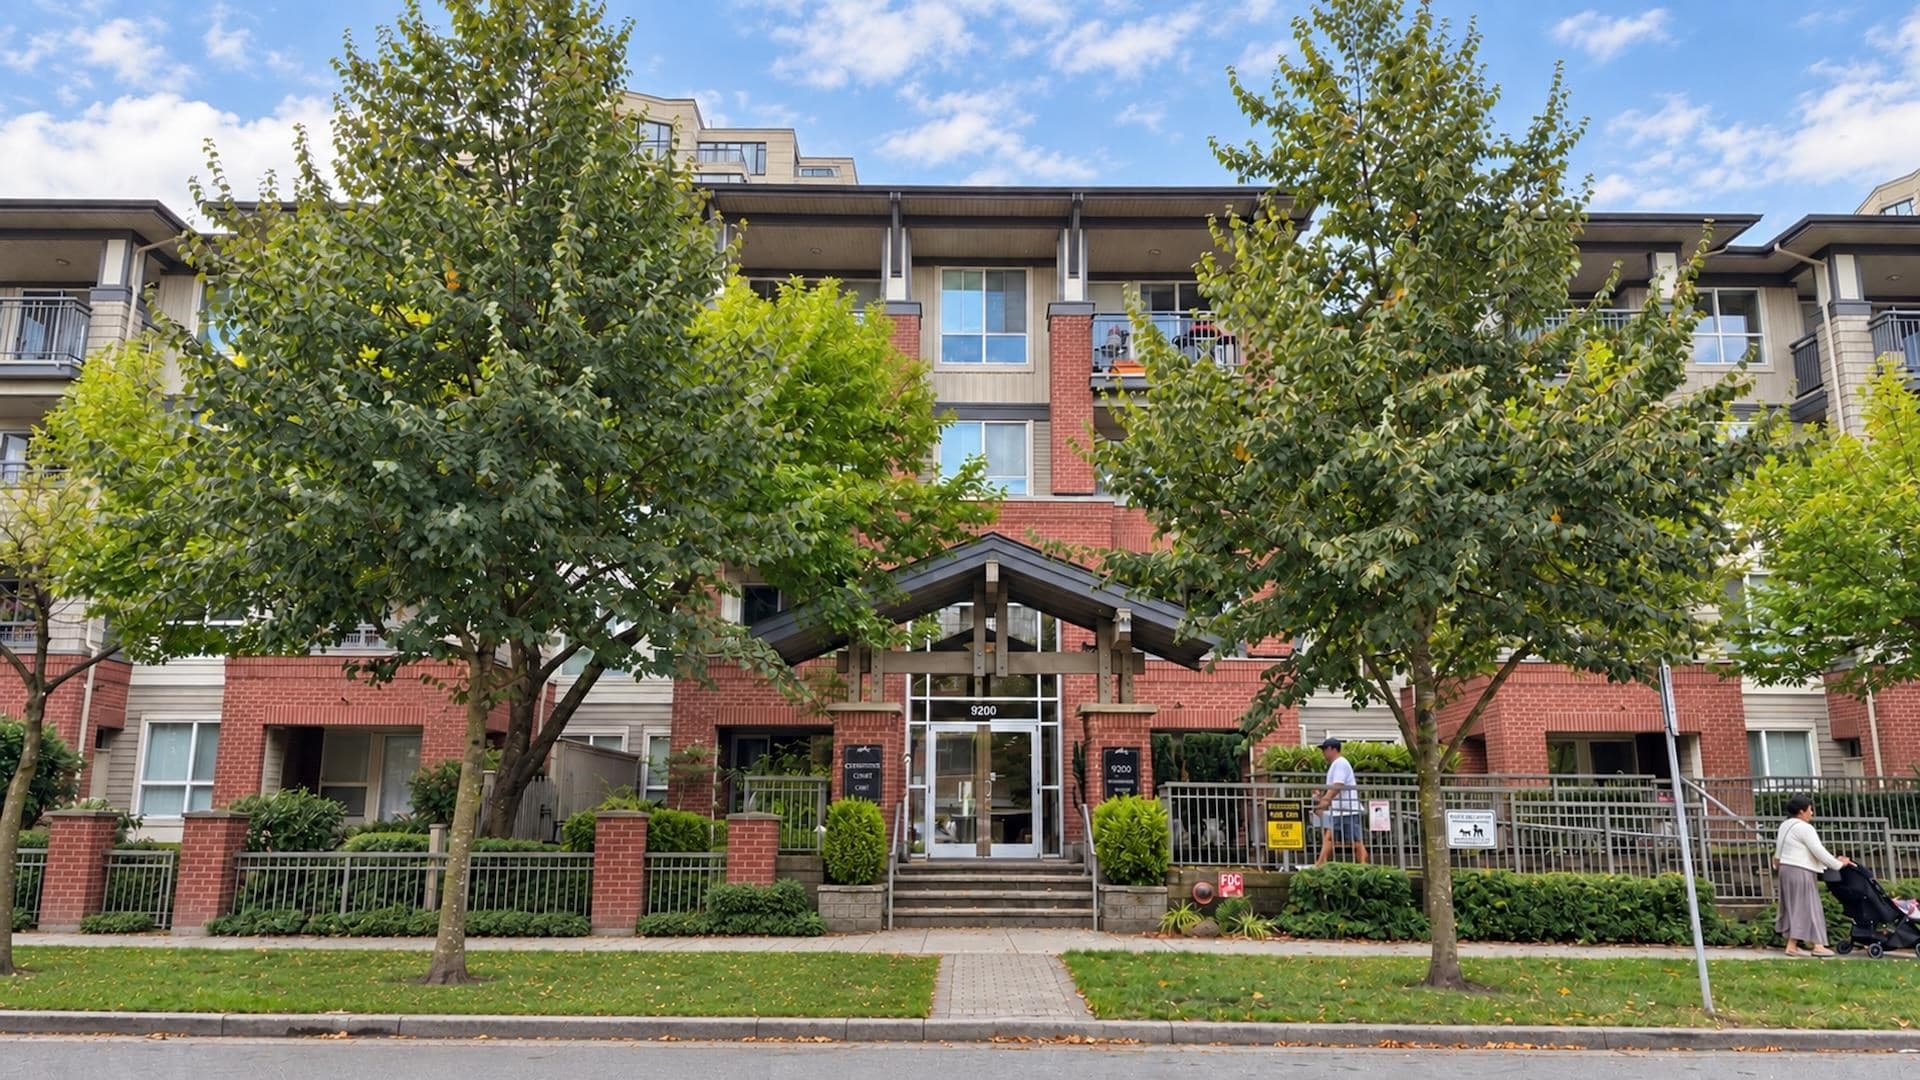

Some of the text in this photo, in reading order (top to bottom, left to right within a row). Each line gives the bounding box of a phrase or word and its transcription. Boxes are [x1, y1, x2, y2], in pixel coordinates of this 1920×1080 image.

[970, 705, 997, 716] 9200
[1111, 765, 1132, 773] 9200
[1221, 874, 1241, 886] FDC
